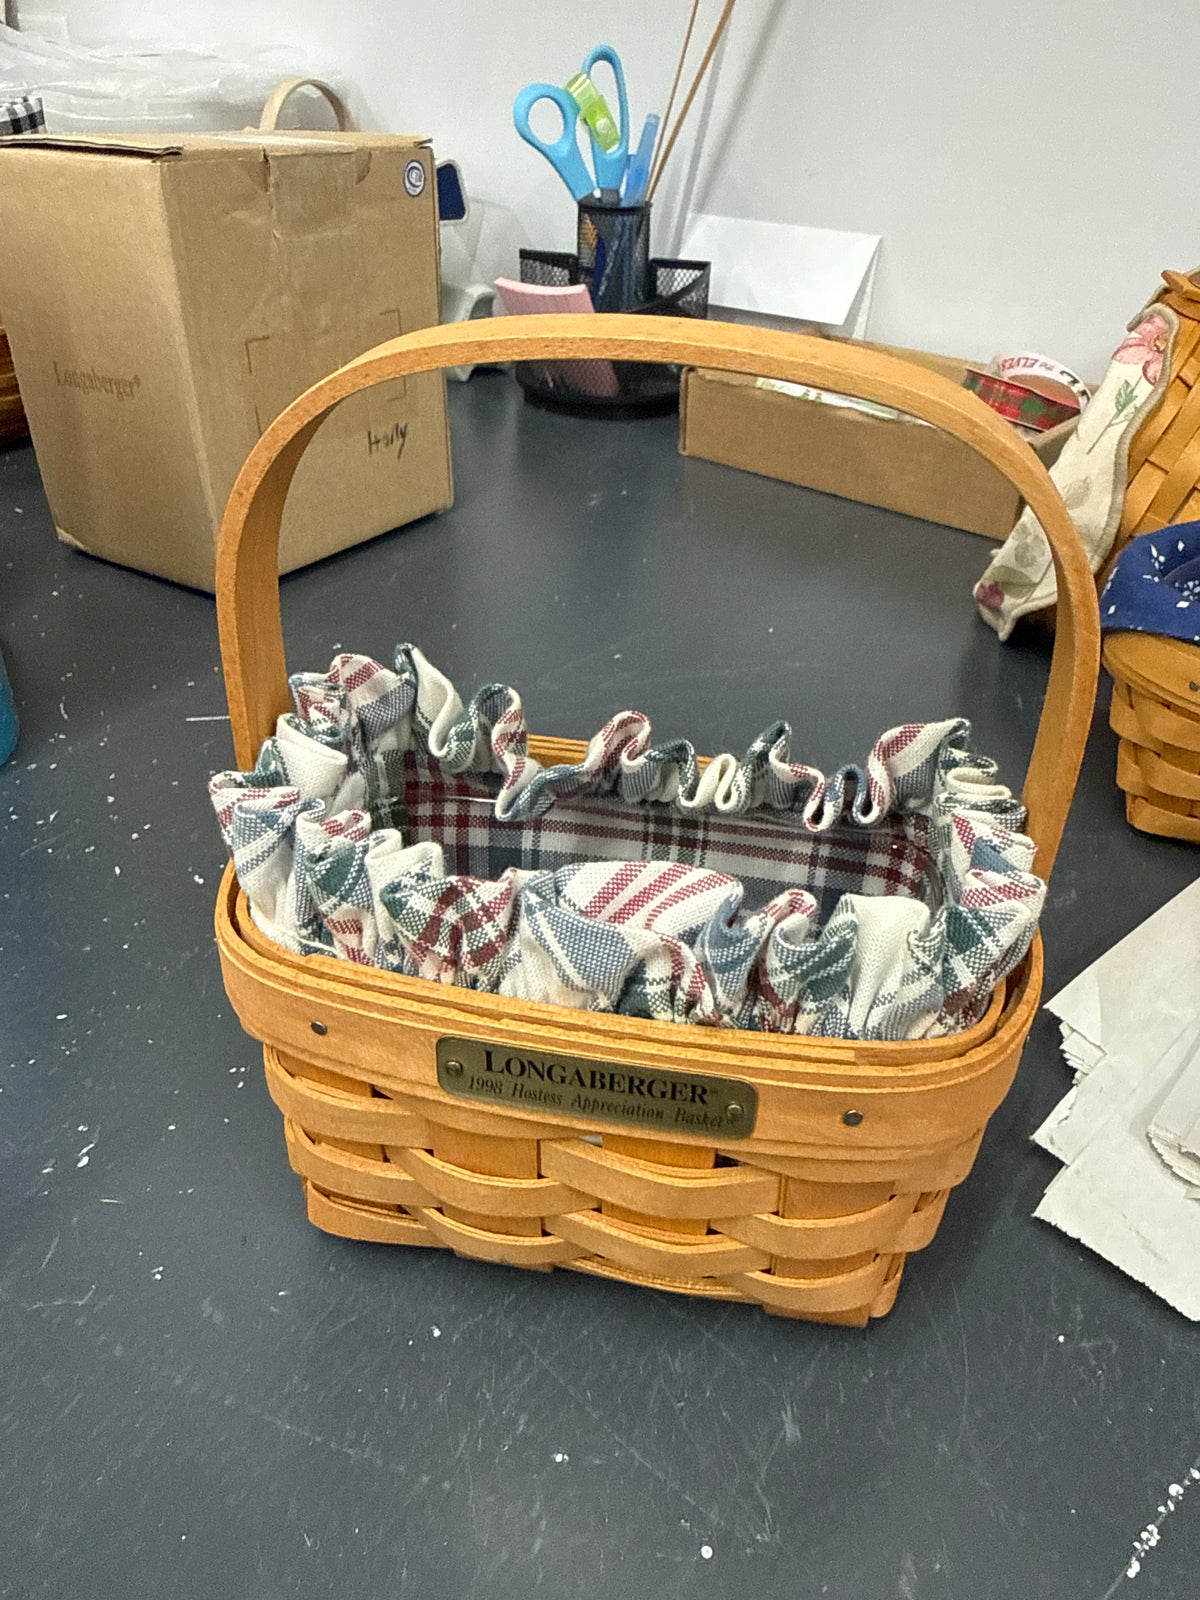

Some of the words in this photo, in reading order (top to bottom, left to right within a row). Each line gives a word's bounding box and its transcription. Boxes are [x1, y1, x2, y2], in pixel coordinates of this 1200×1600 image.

[469, 1075, 504, 1096] 1998
[512, 1082, 562, 1105] Hostess
[570, 1093, 664, 1120] Appreciation
[674, 1107, 723, 1129] Basket
[484, 1049, 709, 1105] LONGABERGER
